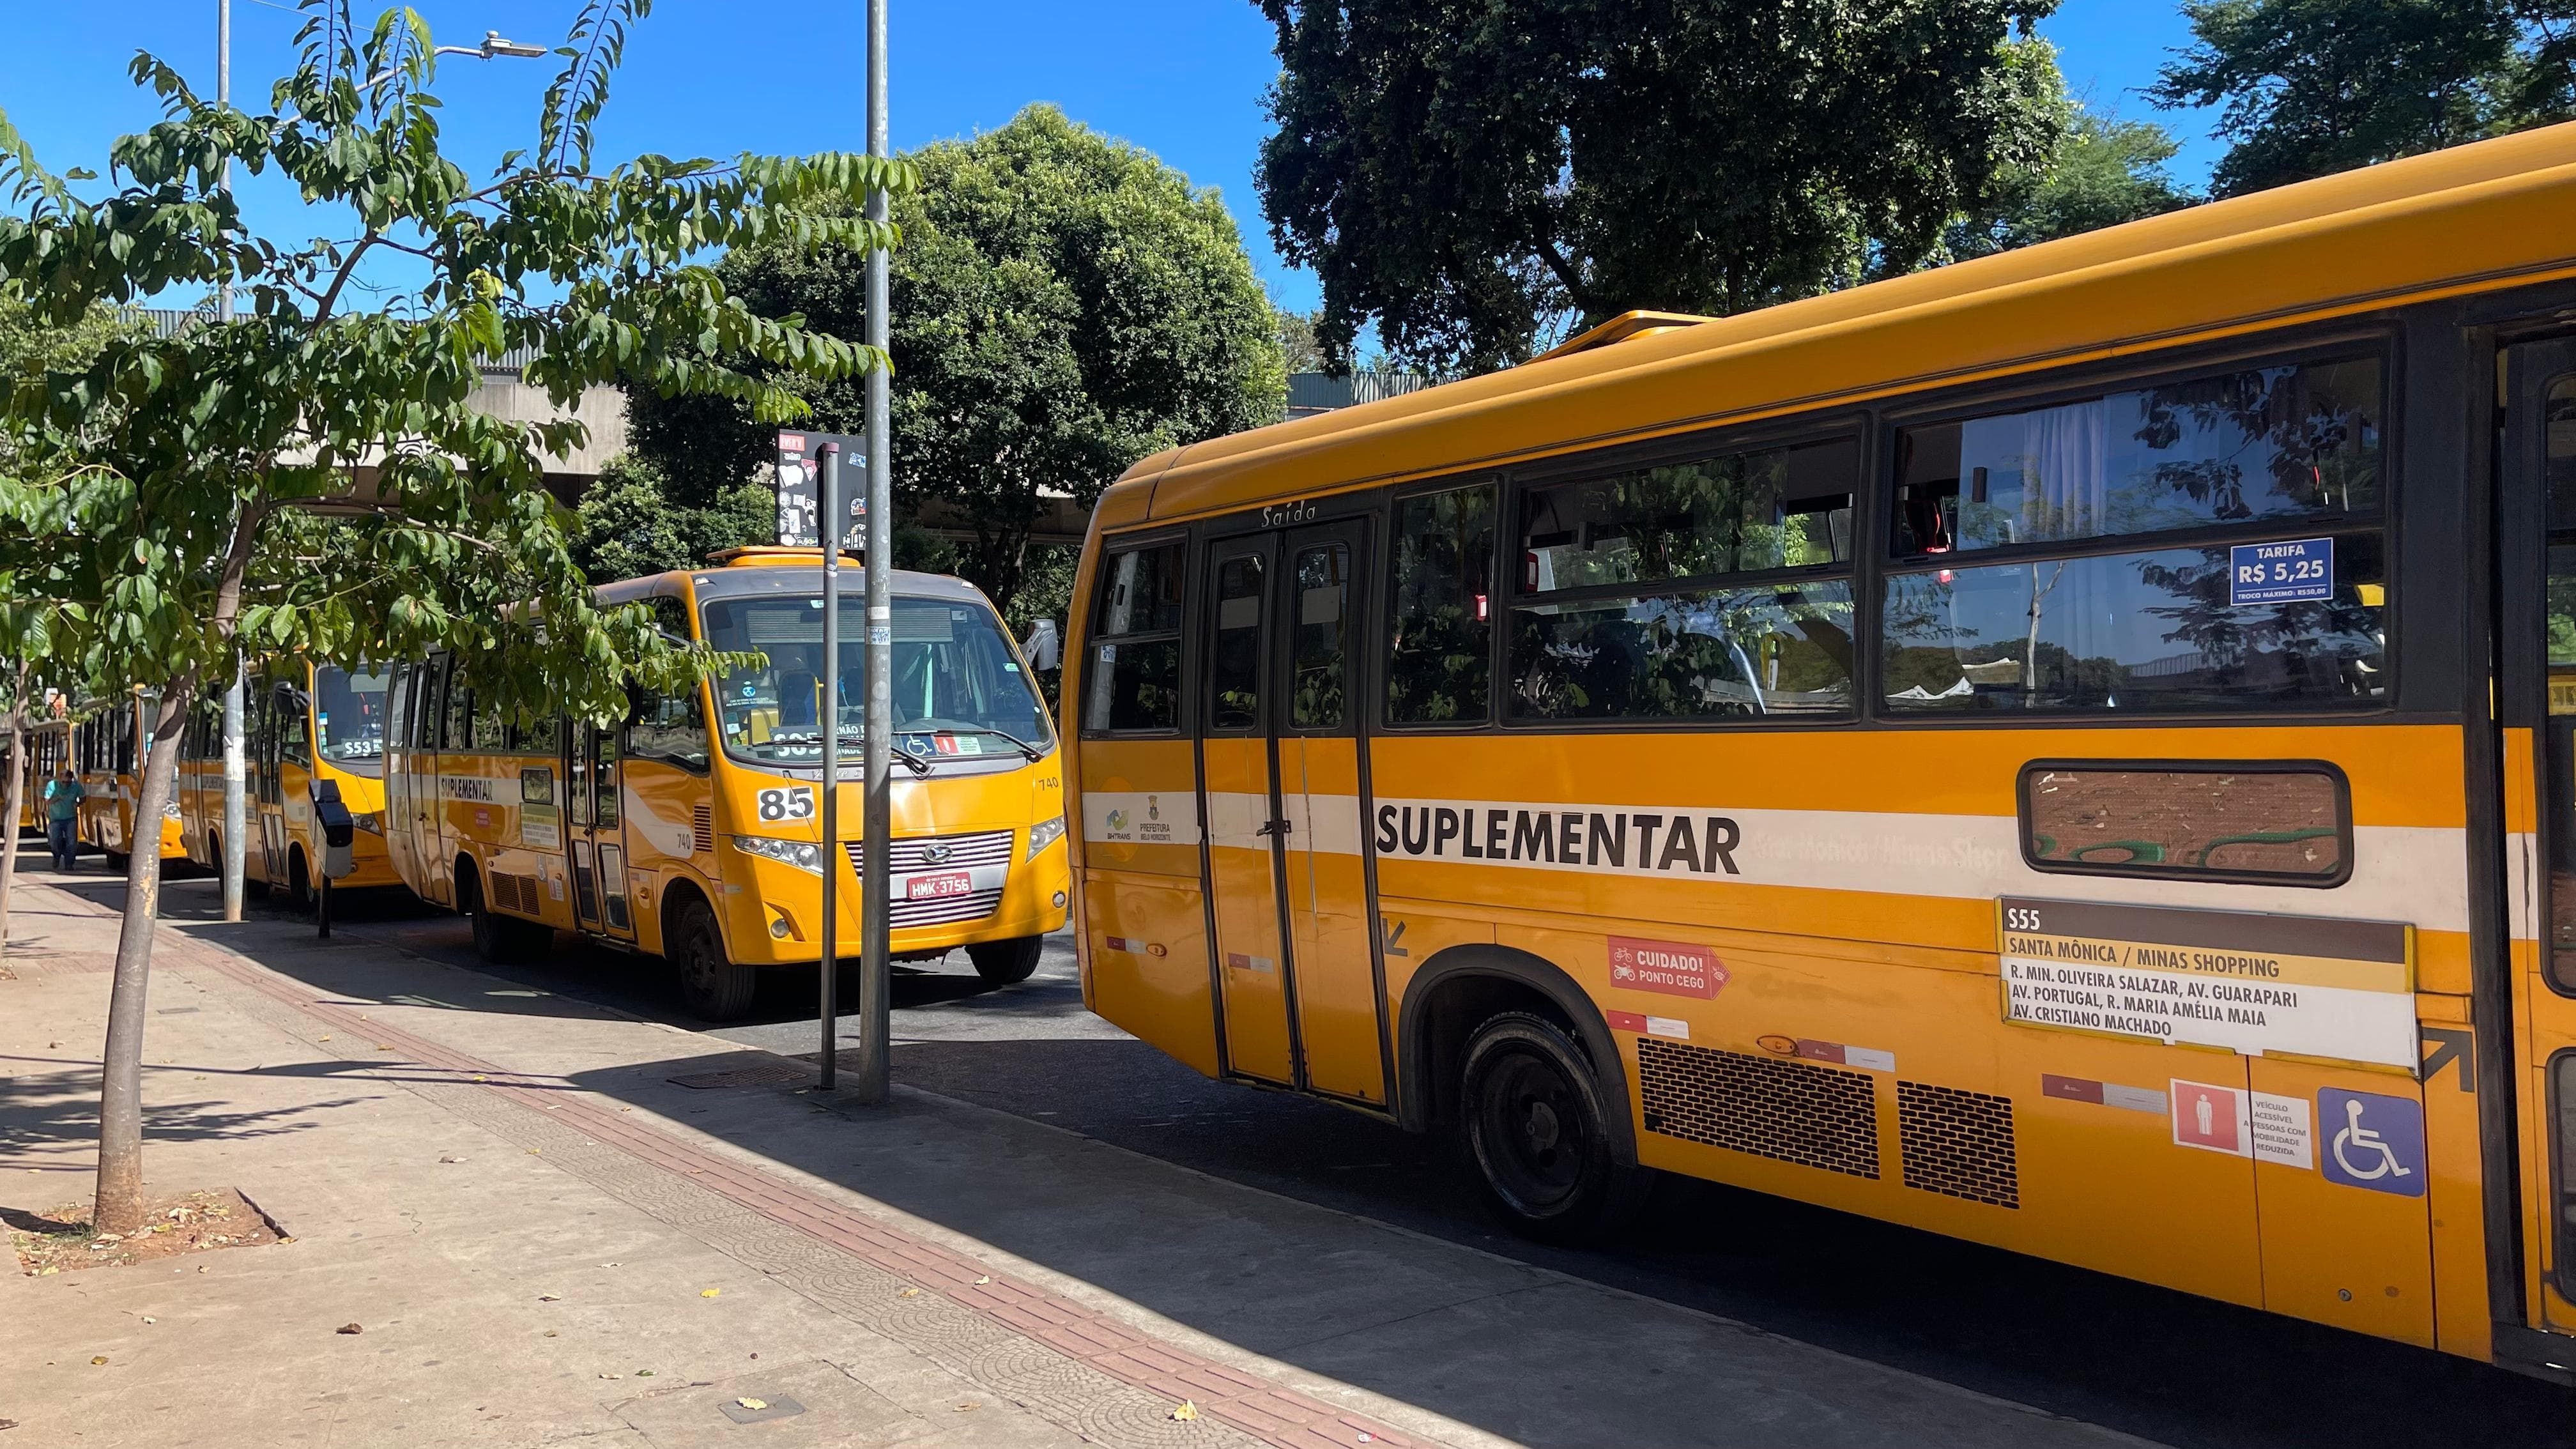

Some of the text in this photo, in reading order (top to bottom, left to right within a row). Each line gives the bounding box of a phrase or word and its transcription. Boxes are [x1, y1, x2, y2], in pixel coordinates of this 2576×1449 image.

[2257, 545, 2305, 559] TARIFA
[2239, 560, 2324, 585] R$ 5,25
[345, 741, 371, 755] S53
[441, 778, 493, 801] SUPLEMENTAR
[1038, 777, 1059, 791] 740
[760, 787, 813, 820] 85
[1140, 824, 1170, 833] PREFEITURA
[677, 833, 691, 850] 740
[1376, 804, 1741, 875] SUPLEMENTAR
[2008, 908, 2041, 930] S55
[1637, 951, 1703, 972] CUIDADO!
[2009, 937, 2280, 977] SANTA MÔNICA / MINAS SHOPPING
[1639, 970, 1705, 988] PONTO CEGO
[2011, 965, 2297, 1008] R. MIN. OLIVEIRA SALAZAR, AV. GUARAPARI
[2012, 985, 2266, 1026] AV. PORTUGAL, R. MARIA AMÉLIA MAIA
[2014, 1004, 2172, 1036] AV. CRISTIANO MACHADO
[2255, 1101, 2288, 1112] VEÍCULO
[2254, 1112, 2293, 1124] ACESSÍVEL
[2252, 1122, 2285, 1133] PESSOAS
[2287, 1128, 2306, 1137] COM
[2253, 1132, 2300, 1146] MOBILIDADE
[2256, 1143, 2295, 1156] REDUZIDA
